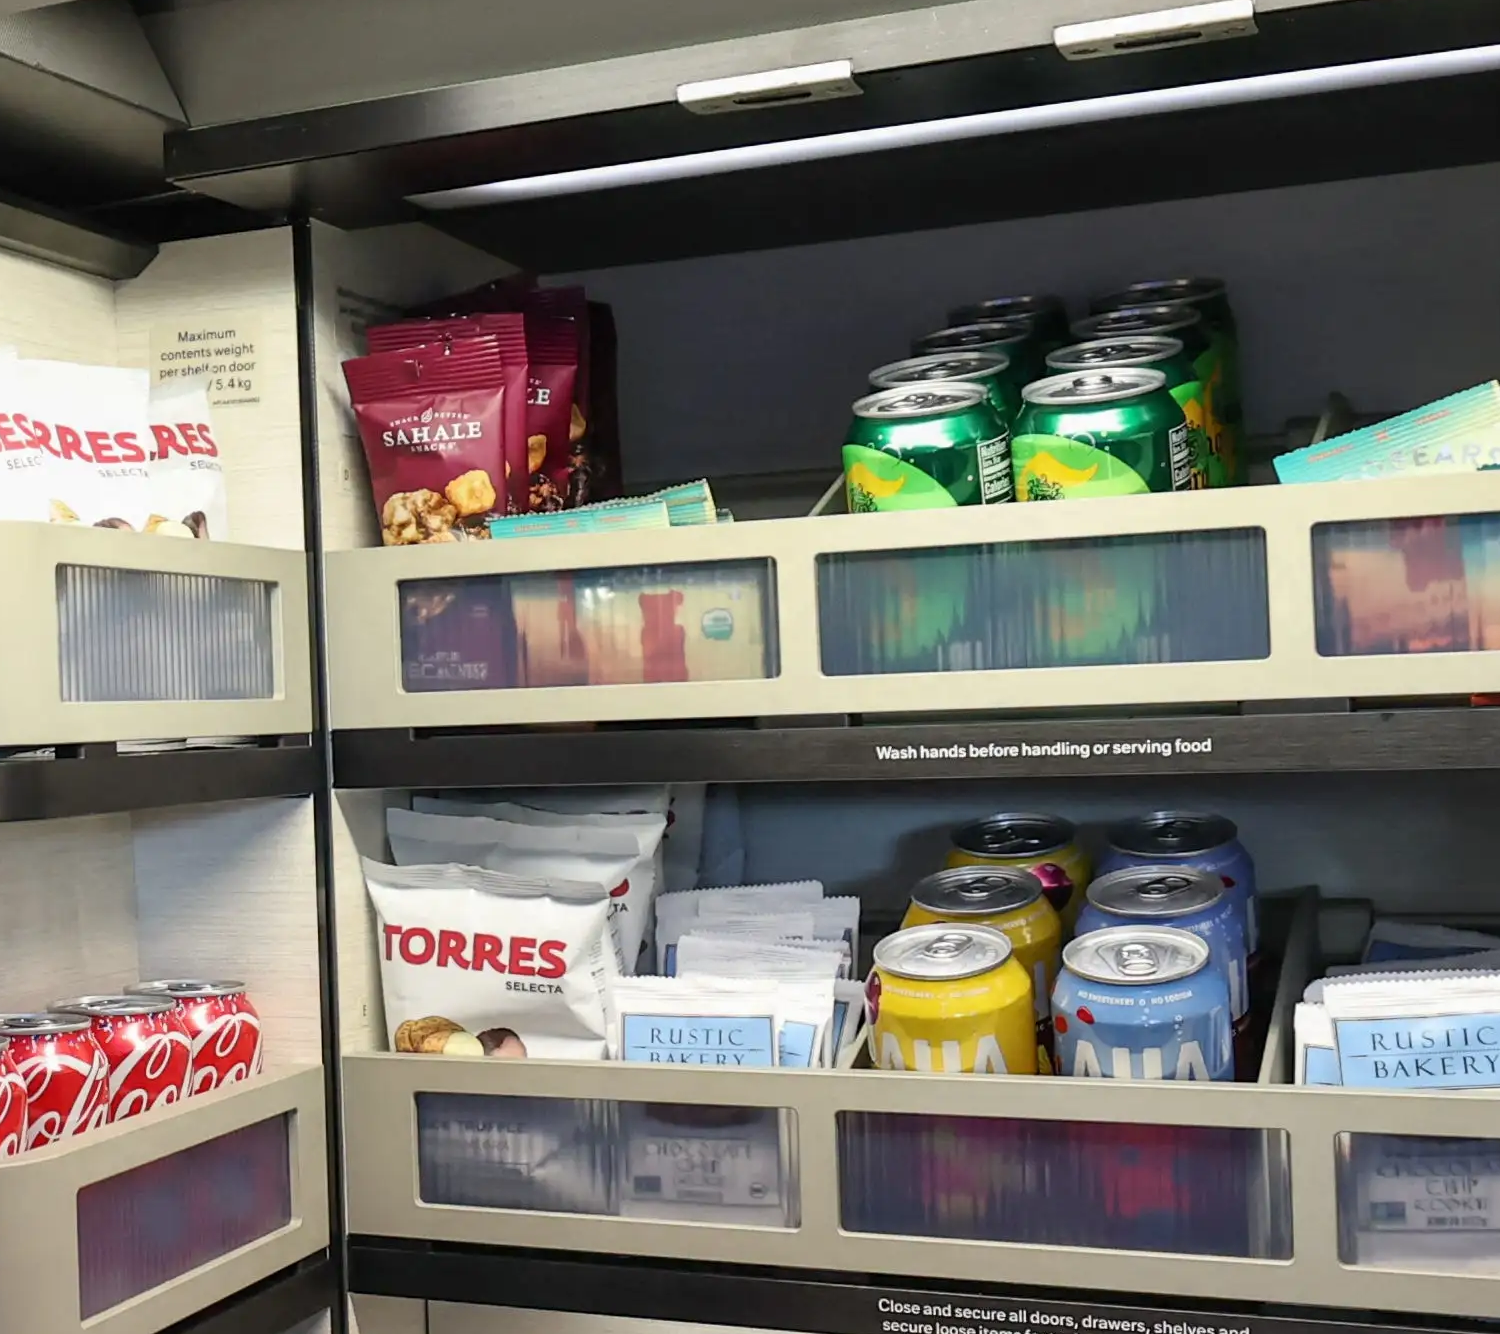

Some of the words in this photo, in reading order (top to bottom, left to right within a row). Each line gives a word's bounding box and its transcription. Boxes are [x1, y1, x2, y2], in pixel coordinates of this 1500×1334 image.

[178, 329, 236, 343] Maximum
[160, 348, 212, 362] contents
[214, 343, 255, 358] weight
[159, 369, 179, 380] per
[229, 361, 257, 373] door
[216, 378, 236, 391] 5.4
[237, 378, 252, 391] kg
[149, 423, 220, 462] RES
[382, 421, 482, 447] SAHALE
[6, 457, 44, 471] SELEC
[876, 744, 918, 760] Wash
[920, 744, 966, 759] hands
[969, 742, 1019, 758] before
[1021, 741, 1091, 758] handling
[1093, 743, 1111, 756] or
[1113, 740, 1172, 757] serving
[1175, 738, 1212, 753] food
[383, 924, 568, 979] TORRES
[505, 980, 564, 995] SELECTA
[650, 1027, 745, 1047] RUSTIC
[1370, 1024, 1499, 1052] RUSTIC
[1372, 1054, 1500, 1079] BAKERY
[878, 1298, 921, 1316] Close
[923, 1302, 951, 1318] and
[955, 1307, 1006, 1322] secure
[1009, 1307, 1027, 1324] all
[1030, 1310, 1078, 1329] doors,
[1082, 1315, 1151, 1334] drawers,
